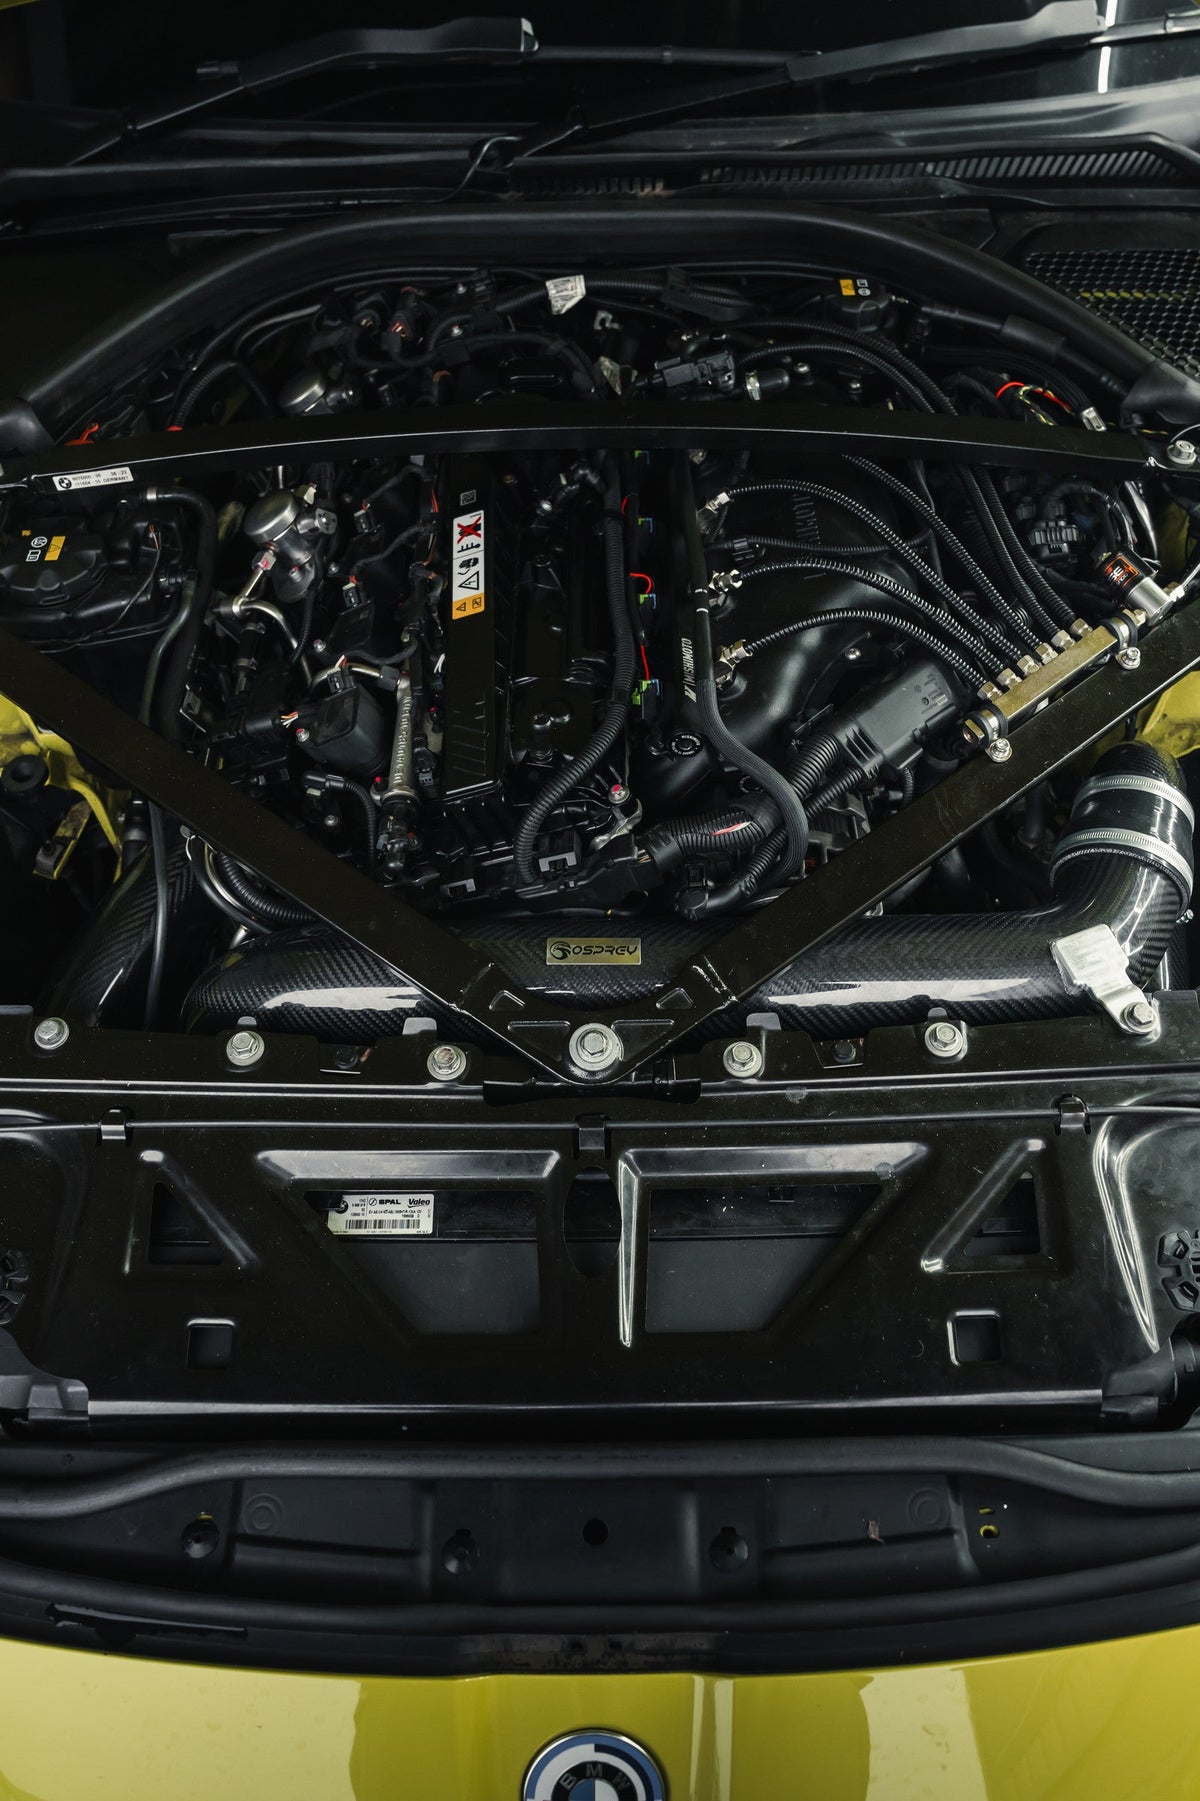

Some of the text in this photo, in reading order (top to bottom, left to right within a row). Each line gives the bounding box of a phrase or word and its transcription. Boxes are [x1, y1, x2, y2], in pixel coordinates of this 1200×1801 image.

[681, 637, 695, 683] MISHIMOTO
[572, 945, 638, 955] OSPREY
[408, 1198, 431, 1207] Valeo
[559, 1763, 631, 1791] BMW
